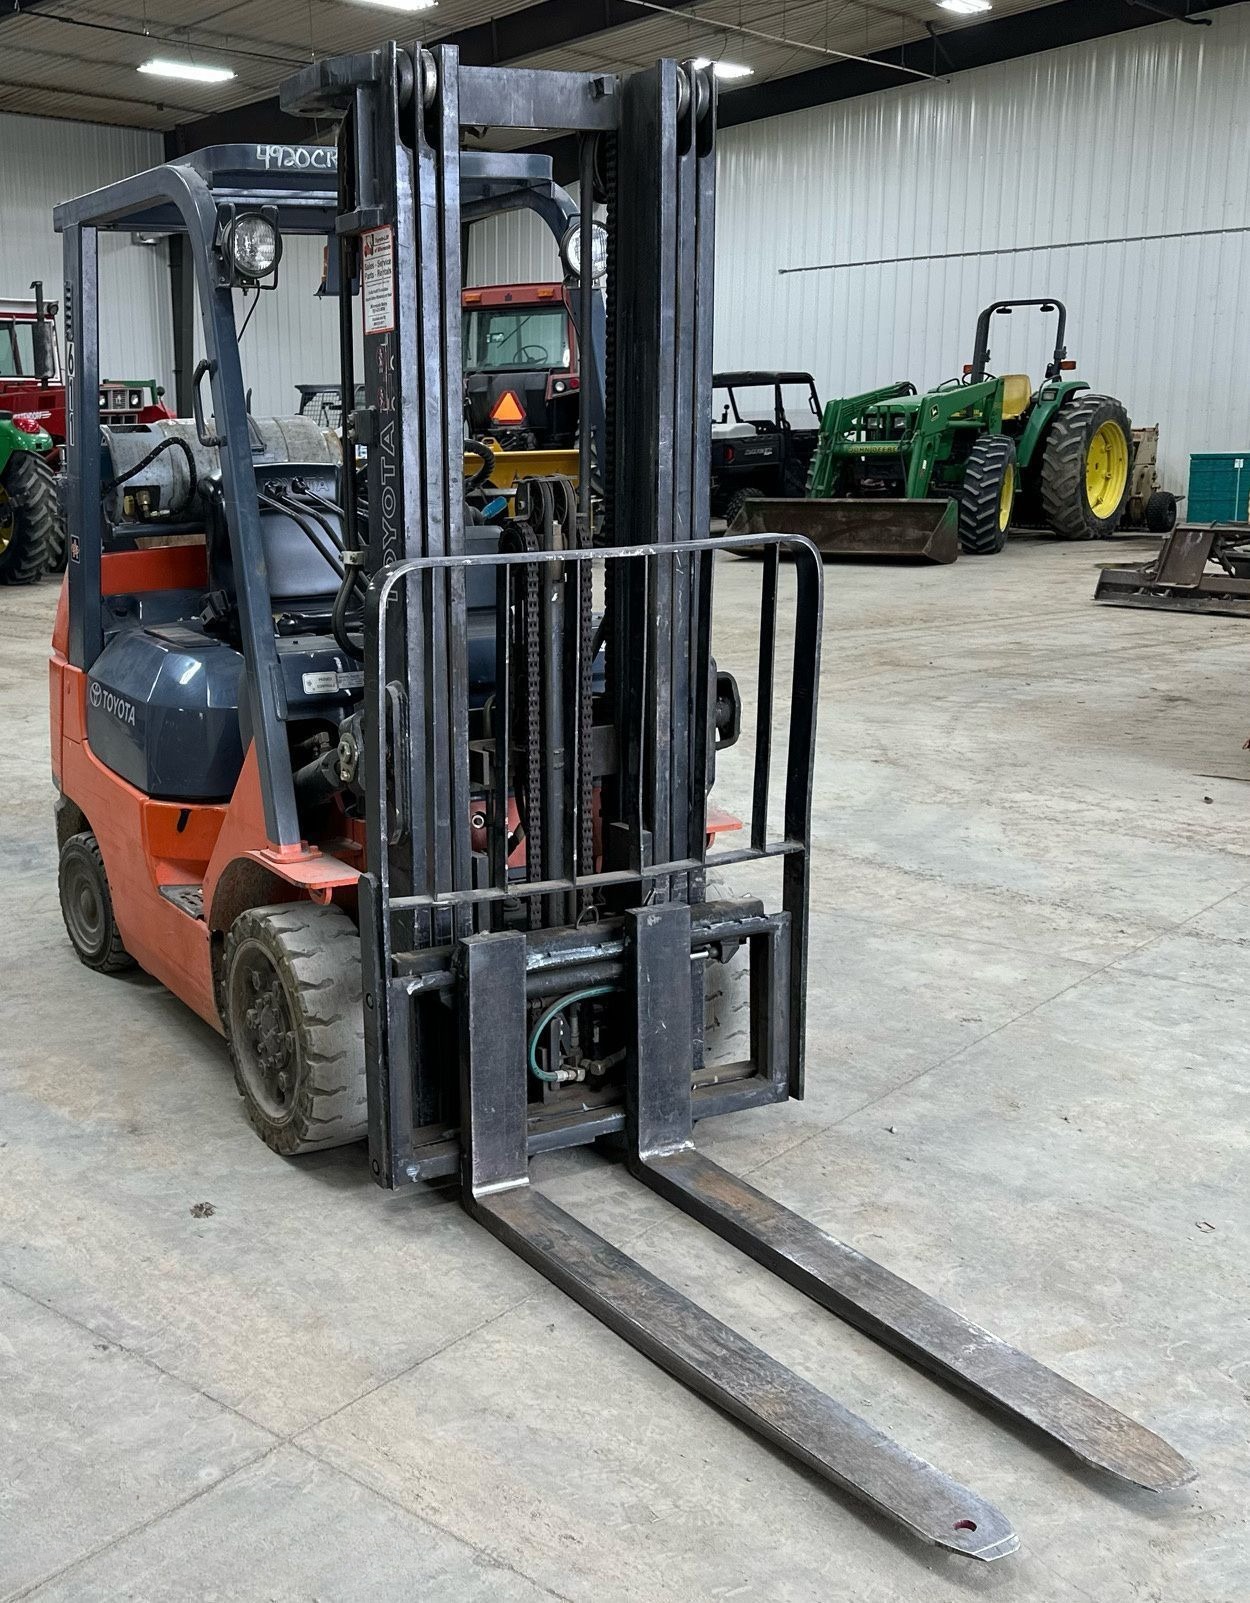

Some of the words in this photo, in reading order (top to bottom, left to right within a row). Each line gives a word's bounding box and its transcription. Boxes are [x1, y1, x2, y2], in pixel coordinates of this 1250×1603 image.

[365, 262, 374, 270] Sales
[377, 259, 391, 268] Service
[365, 272, 374, 280] Parts
[103, 690, 135, 726] TOYOTA
